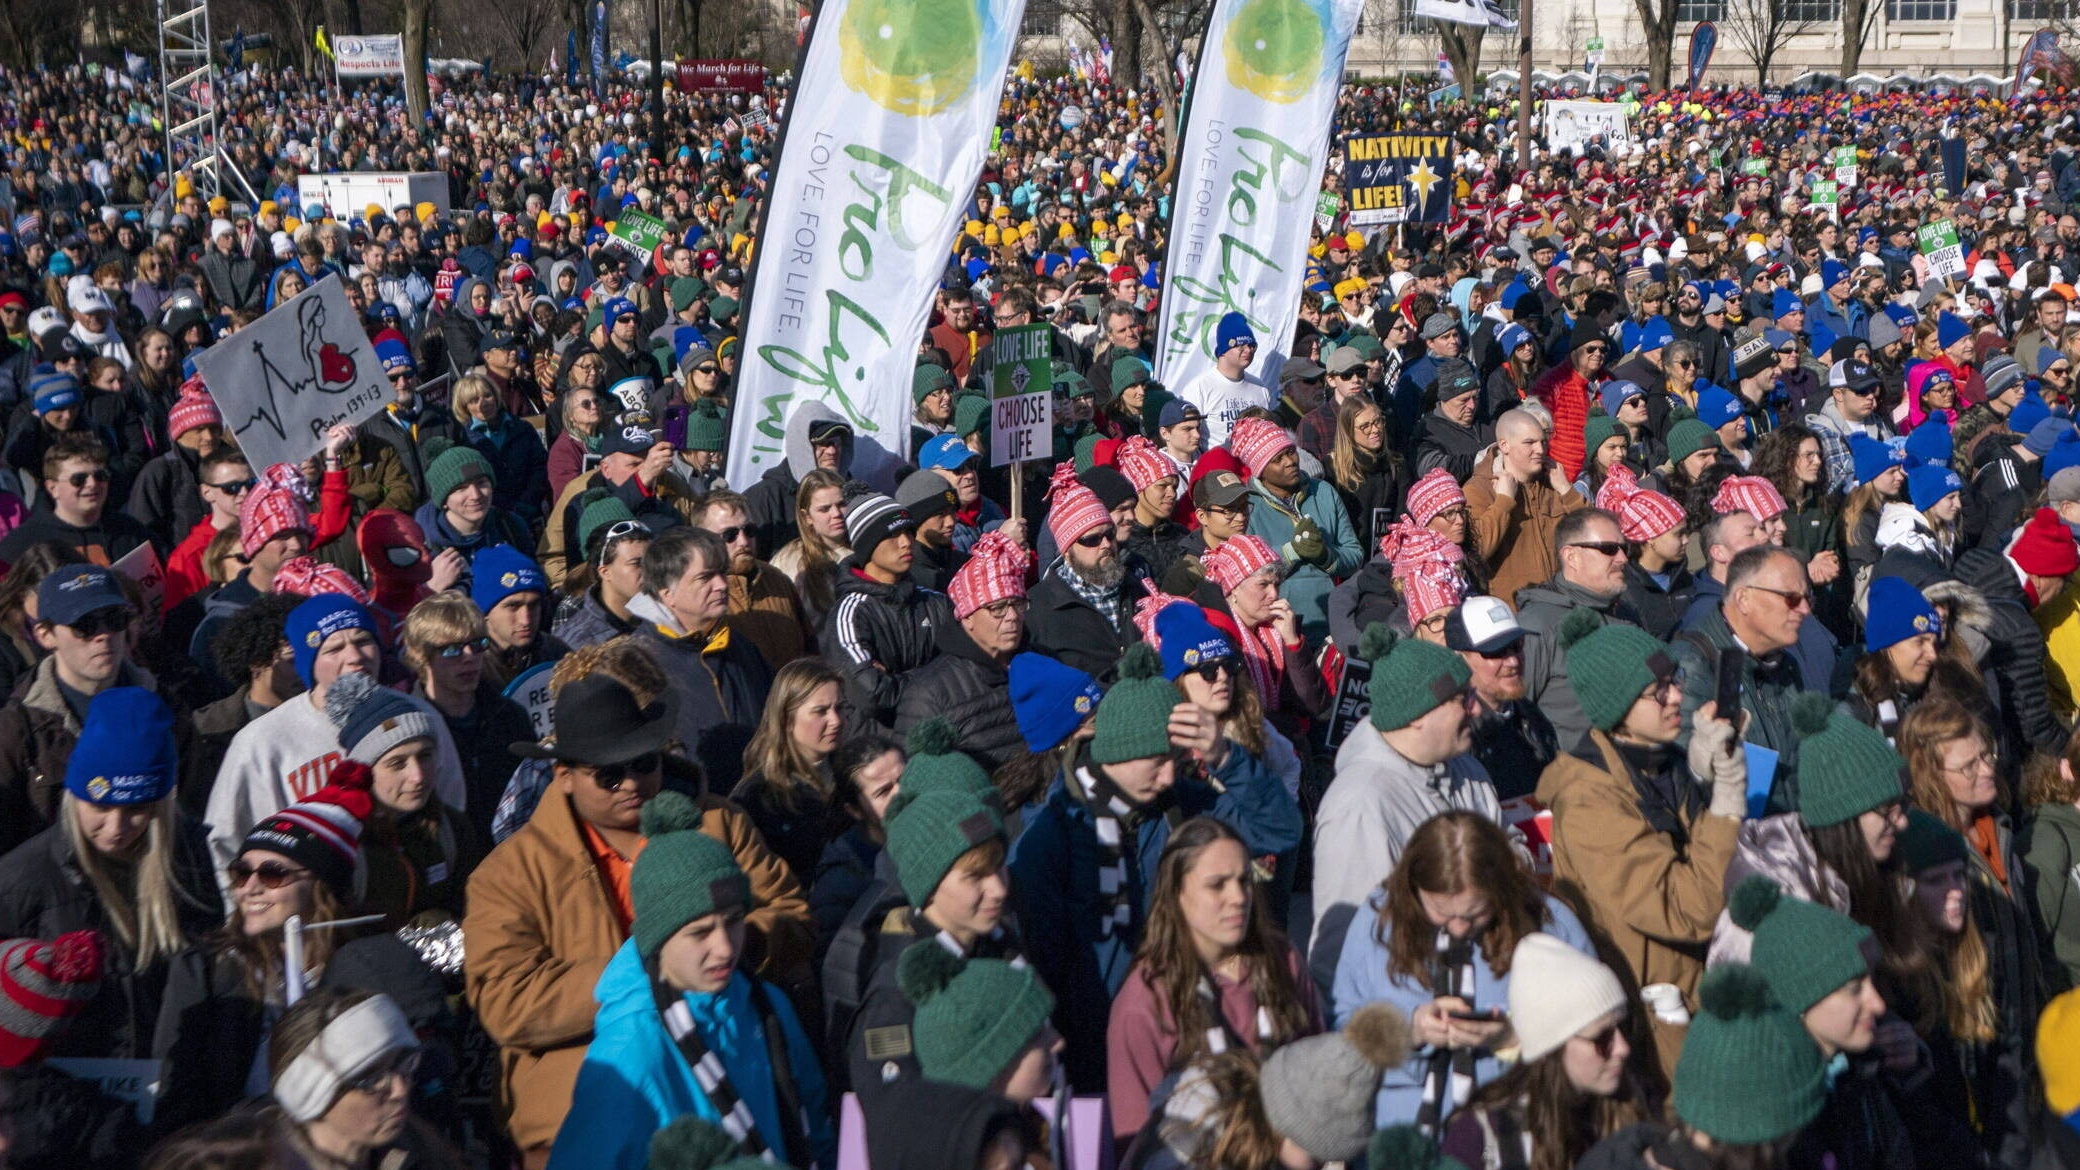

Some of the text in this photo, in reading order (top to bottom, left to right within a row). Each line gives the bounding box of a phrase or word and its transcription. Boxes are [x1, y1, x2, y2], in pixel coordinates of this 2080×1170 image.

[340, 60, 400, 69] Respects Life
[681, 63, 760, 75] We March for Life
[1348, 136, 1449, 161] NATIVITY
[1362, 159, 1394, 185] is for
[1193, 178, 1214, 217] FOR
[1352, 185, 1403, 210] LIFE!
[622, 213, 664, 239] LOVE LIFE
[790, 211, 821, 265] FOR
[1918, 220, 1953, 243] LOVE LIFE
[1929, 245, 1958, 266] CHOOSE
[1939, 261, 1956, 277] LIFE
[777, 271, 810, 334] LIFE.
[996, 330, 1049, 365] LOVE LIFE
[310, 385, 381, 441] Psalm 139:13
[998, 395, 1045, 430] CHOOSE
[1226, 397, 1240, 409] Life
[1009, 429, 1033, 460] LIFE
[317, 609, 359, 627] MARCH
[322, 618, 361, 636] for LIFE
[1202, 650, 1215, 660] for
